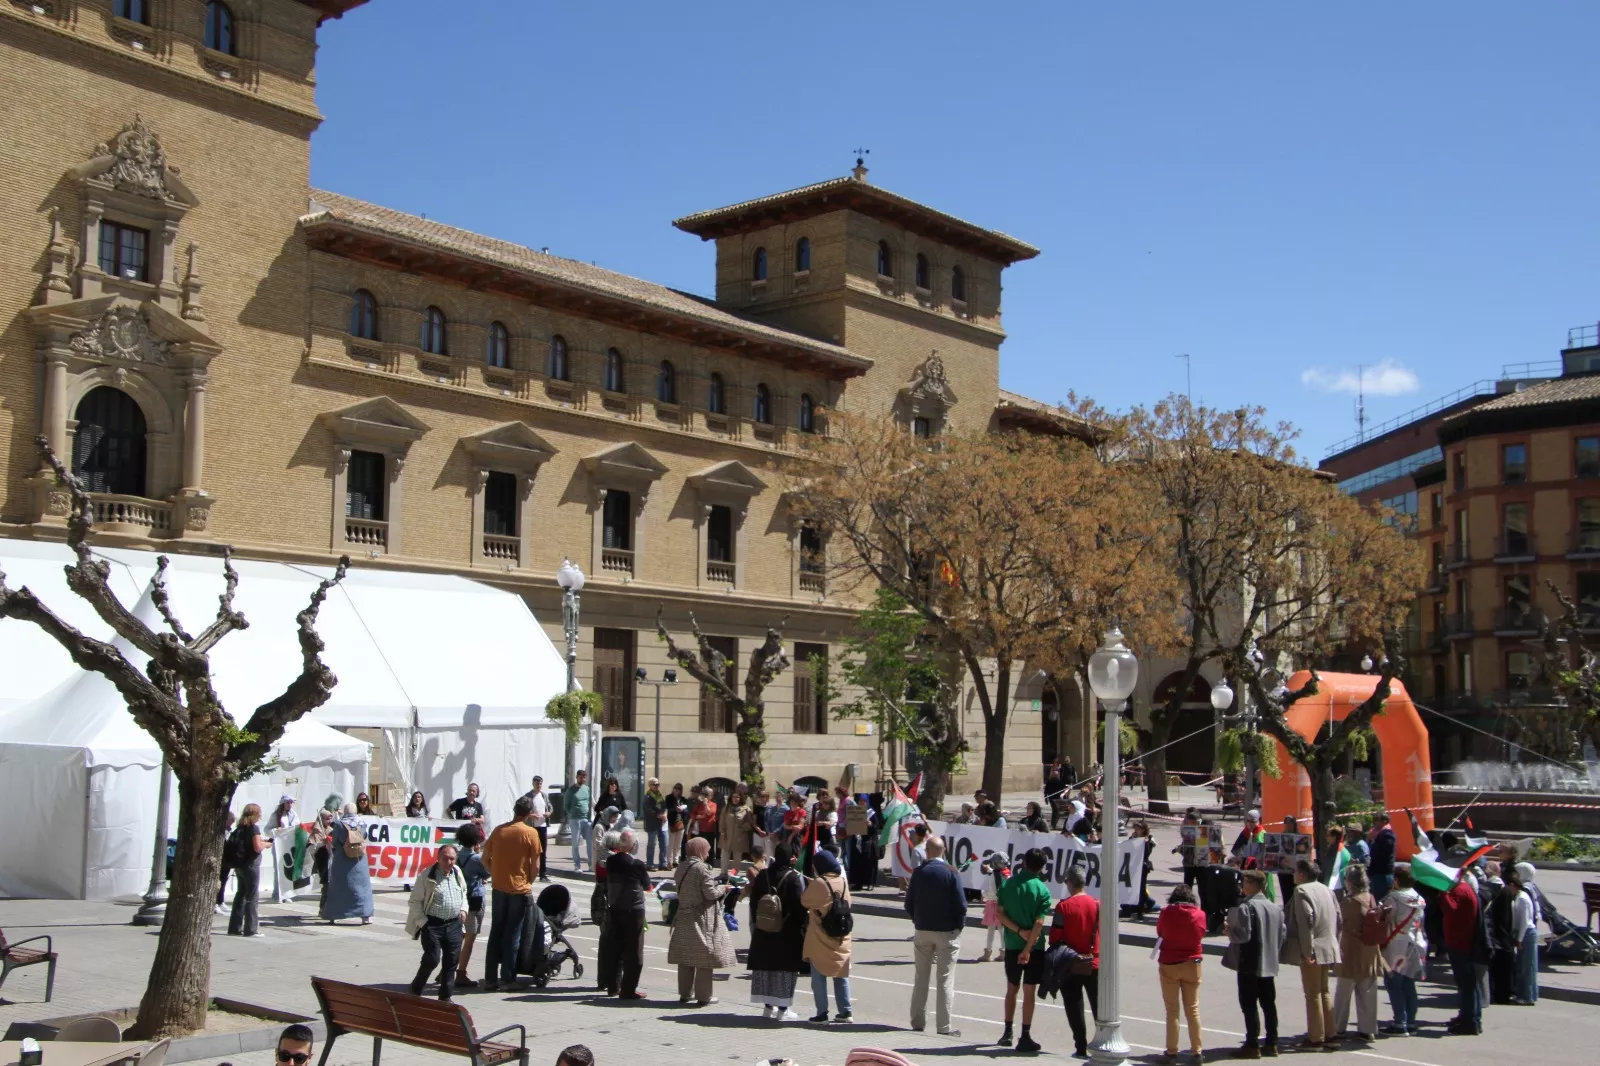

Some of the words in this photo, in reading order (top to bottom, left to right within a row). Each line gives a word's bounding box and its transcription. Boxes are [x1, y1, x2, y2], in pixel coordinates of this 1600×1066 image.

[362, 823, 390, 843] CA
[400, 824, 431, 843] CON
[366, 846, 439, 879] ESTIN
[941, 835, 973, 872] NO
[1040, 846, 1132, 888] GUERA
